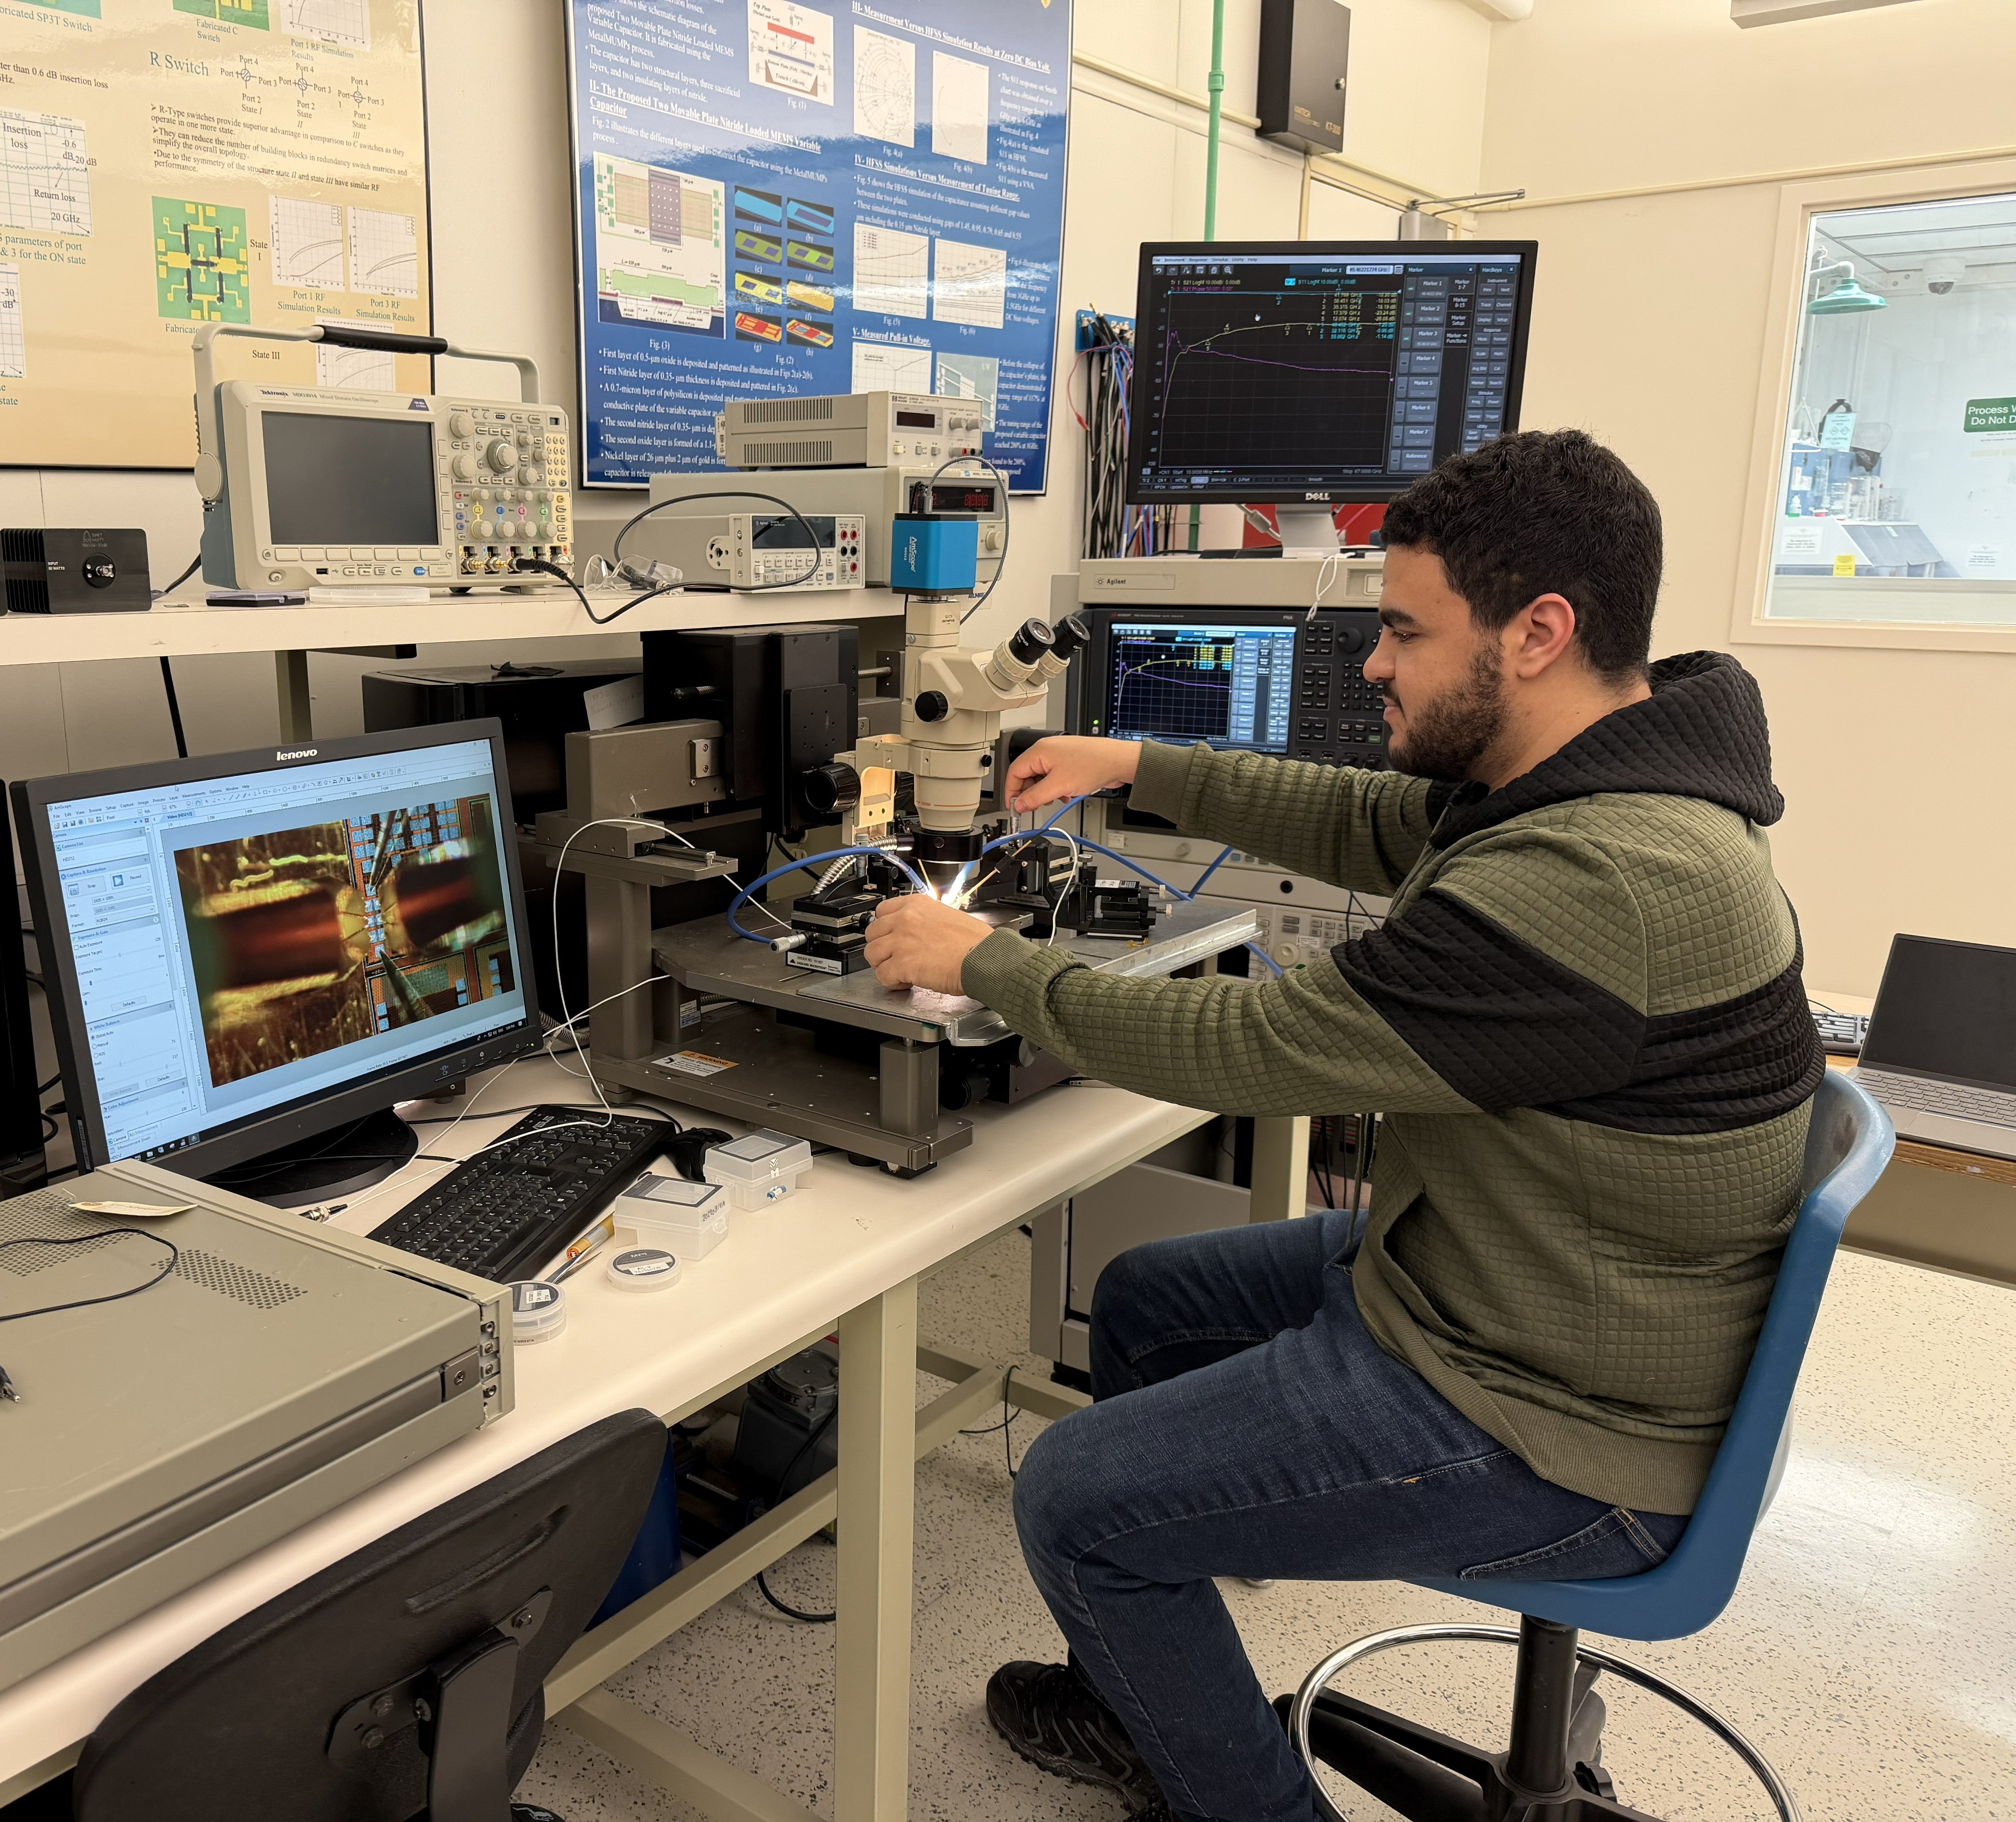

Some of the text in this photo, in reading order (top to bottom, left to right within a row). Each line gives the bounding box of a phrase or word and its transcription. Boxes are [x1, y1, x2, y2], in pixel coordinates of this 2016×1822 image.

[37, 12, 60, 25] SP3T
[63, 18, 92, 32] Switch
[196, 19, 231, 34] Fabricated
[197, 31, 220, 43] Switch
[864, 5, 903, 27] Measurement
[905, 19, 924, 34] Versus
[925, 26, 942, 40] HFSS
[942, 31, 972, 49] Simulation
[973, 41, 993, 55] Results
[1001, 50, 1014, 61] Zero
[1015, 54, 1024, 65] DC
[1025, 57, 1037, 68] Bias
[291, 38, 303, 48] Port
[311, 43, 319, 51] RF
[322, 46, 354, 59] Simulation
[291, 50, 314, 61] Results
[149, 51, 209, 77] R Switch
[0, 62, 108, 88] ter than 0.6 dB insertion loss
[590, 96, 627, 115] Capacitor
[601, 82, 616, 96] The
[618, 87, 651, 106] Proposed
[653, 97, 668, 111] Two
[671, 102, 700, 120] Movable
[702, 111, 718, 125] Plate
[720, 116, 744, 132] Nitride
[745, 123, 769, 139] Loaded
[771, 130, 793, 144] MEMS
[795, 136, 821, 151] Variable
[3, 122, 41, 137] Insertion
[151, 115, 176, 125] operate
[178, 118, 184, 126] in
[219, 127, 235, 135] state.
[159, 105, 185, 119] R-Type
[187, 112, 215, 122] switches
[217, 118, 241, 127] provide
[243, 121, 268, 132] superior
[270, 126, 301, 139] advantage
[310, 134, 344, 145] comparison
[359, 143, 383, 152] switches
[393, 148, 404, 157] they
[11, 138, 28, 149] loss
[62, 139, 76, 148] -0.6
[153, 137, 249, 160] simplify the overall topology.
[63, 151, 73, 159] dB
[158, 128, 176, 139] They
[191, 134, 213, 144] reduce
[215, 137, 225, 145] the
[227, 141, 250, 150] number
[261, 146, 286, 157] building
[288, 150, 307, 159] blocks
[317, 156, 350, 168] redundancy
[353, 162, 370, 170] switch
[372, 165, 395, 174] matrices
[72, 156, 97, 166] -20 dB
[34, 189, 76, 202] Return loss
[51, 212, 80, 223] 20 GHz
[6, 235, 52, 248] parameters
[54, 240, 64, 248] of
[65, 242, 82, 251] port
[250, 239, 268, 249] State
[0, 247, 86, 265] & 3 for the ON state
[258, 253, 261, 261] I
[2, 288, 14, 297] -30
[293, 290, 307, 299] Port
[315, 293, 325, 302] RF
[3, 301, 14, 309] dB
[278, 301, 341, 315] Simulation Results
[370, 299, 384, 307] Port
[391, 301, 401, 309] RF
[356, 309, 415, 322] Simulation Results
[650, 339, 670, 351] Fig. (3)
[252, 350, 280, 360] State III
[603, 348, 616, 358] First
[617, 350, 631, 361] layer
[633, 353, 640, 361] of
[661, 356, 676, 365] oxide
[677, 356, 682, 365] is
[682, 358, 708, 369] deposited
[708, 362, 718, 370] and
[719, 364, 742, 372] patterned
[749, 365, 773, 376] illustrated
[780, 368, 790, 379] Figs
[260, 390, 288, 398] Tektronix
[1968, 407, 2009, 415] Process
[1988, 416, 2007, 424] Not
[276, 749, 317, 761] lenovo
